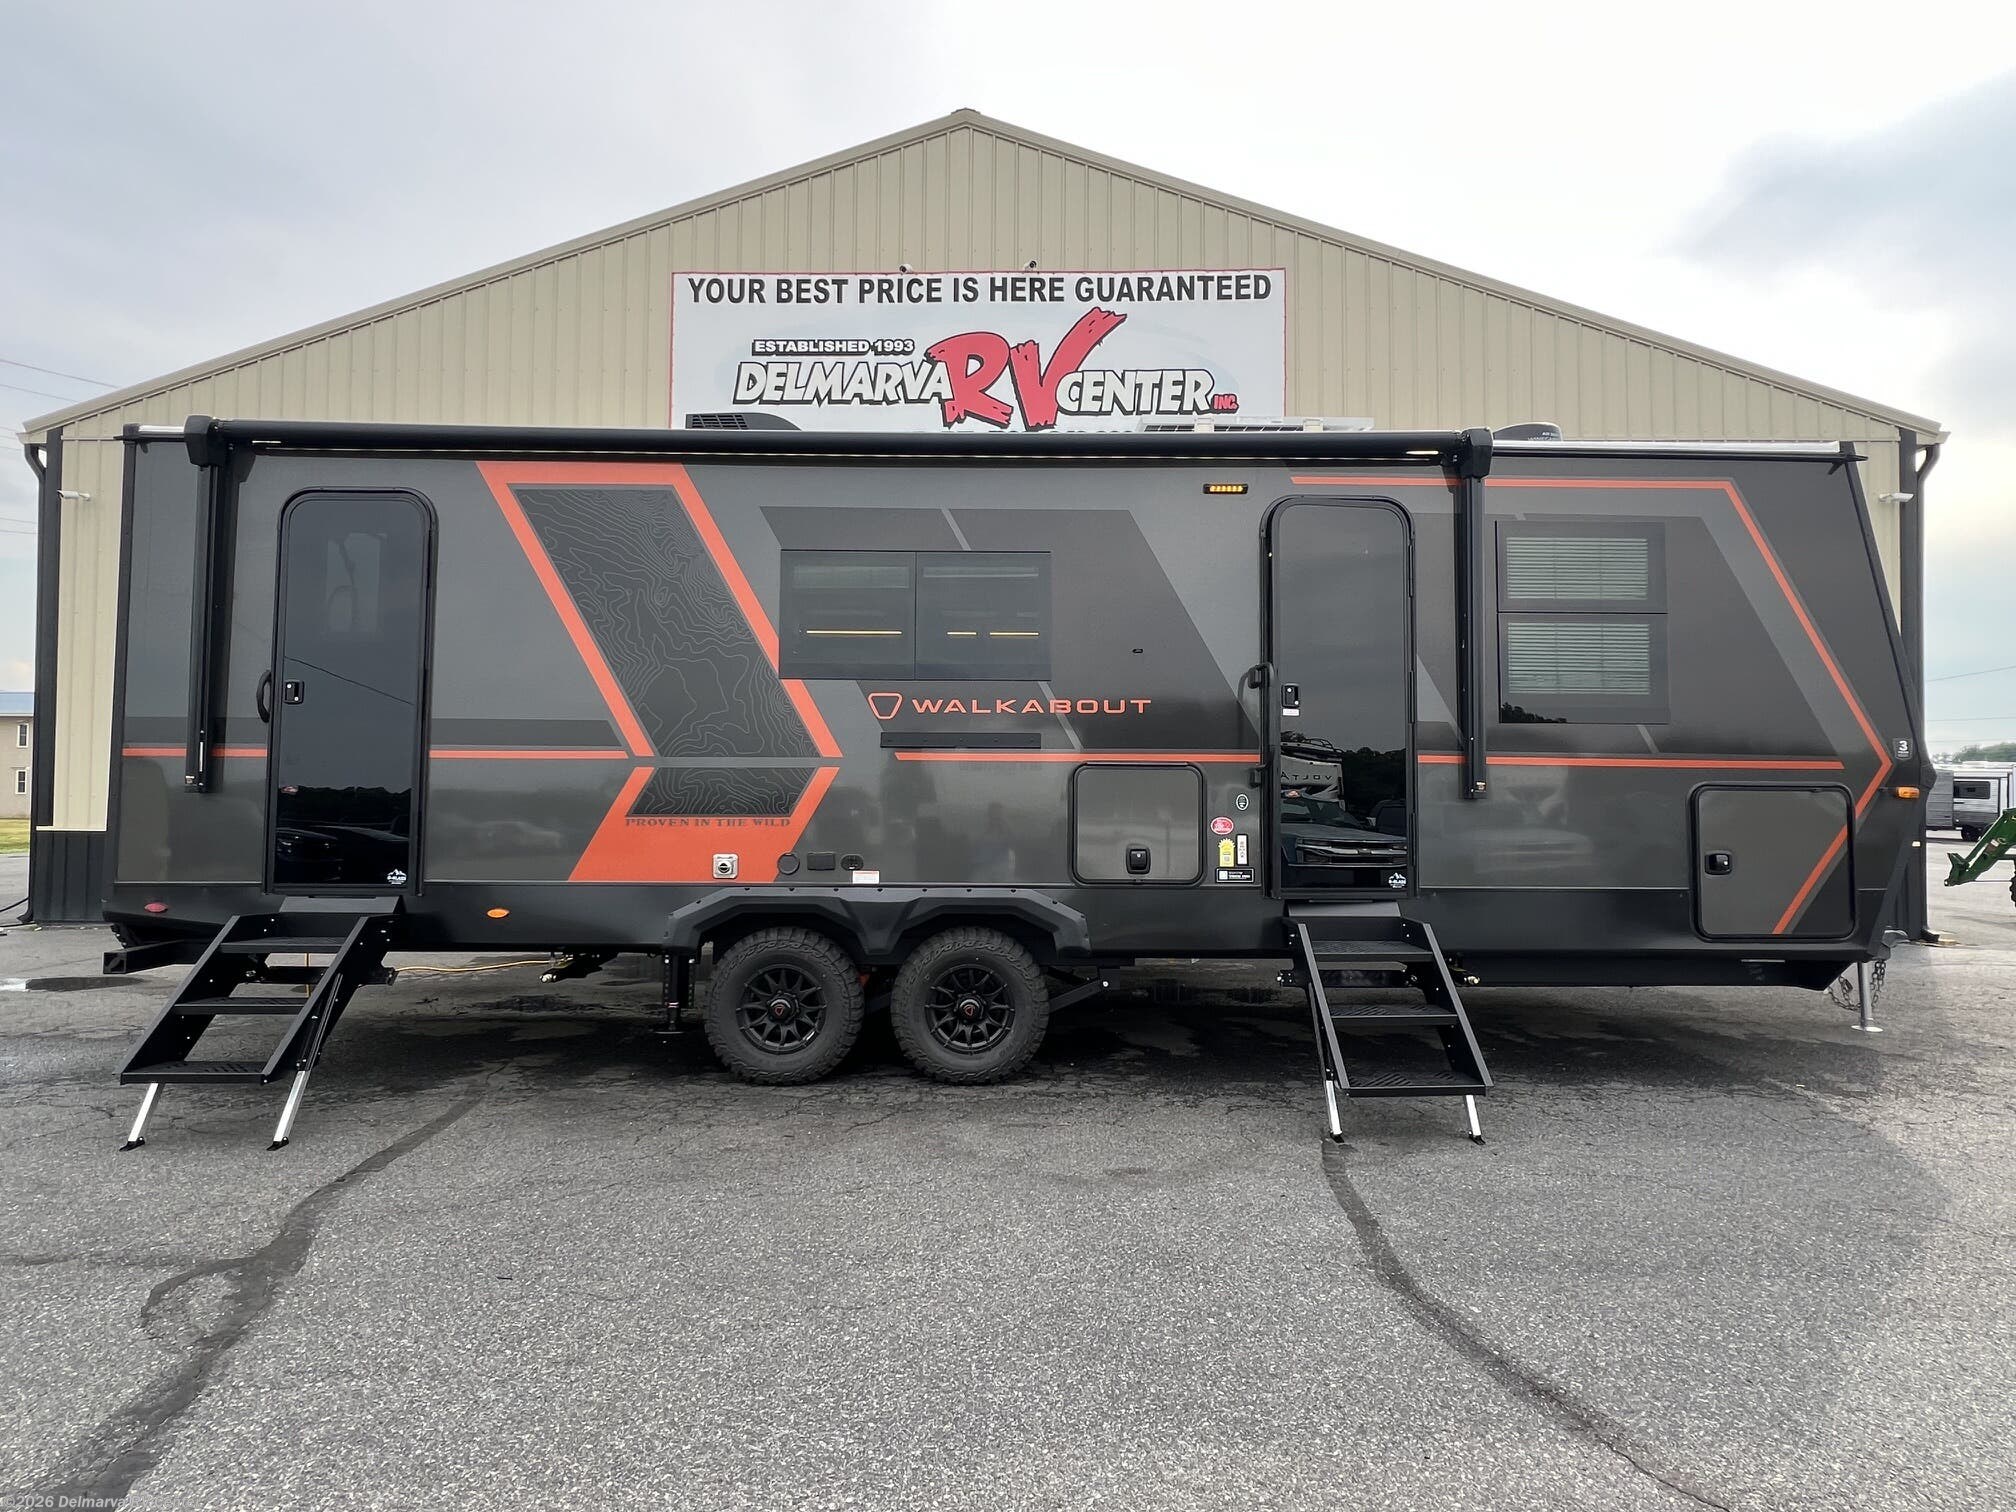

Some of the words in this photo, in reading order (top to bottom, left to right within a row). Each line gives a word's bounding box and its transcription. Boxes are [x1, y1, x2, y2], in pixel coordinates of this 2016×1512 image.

[688, 277, 766, 303] YOUR
[776, 278, 849, 303] BEST
[858, 278, 942, 303] PRICE
[953, 277, 979, 302] IS
[990, 277, 1065, 302] HERE
[1075, 274, 1272, 302] GUARANTEED
[753, 339, 872, 355] ESTABLISHED
[874, 339, 915, 355] 1993
[733, 361, 954, 407] DELMARVA
[925, 306, 1127, 429] RV
[1056, 369, 1216, 415] CENTER
[1210, 394, 1240, 414] INC.
[911, 698, 1152, 715] WALKABOUT
[1898, 740, 1908, 751] 3
[625, 818, 690, 827] PROVEN
[695, 818, 710, 827] IN
[717, 818, 747, 827] THE
[753, 818, 790, 827] WILD
